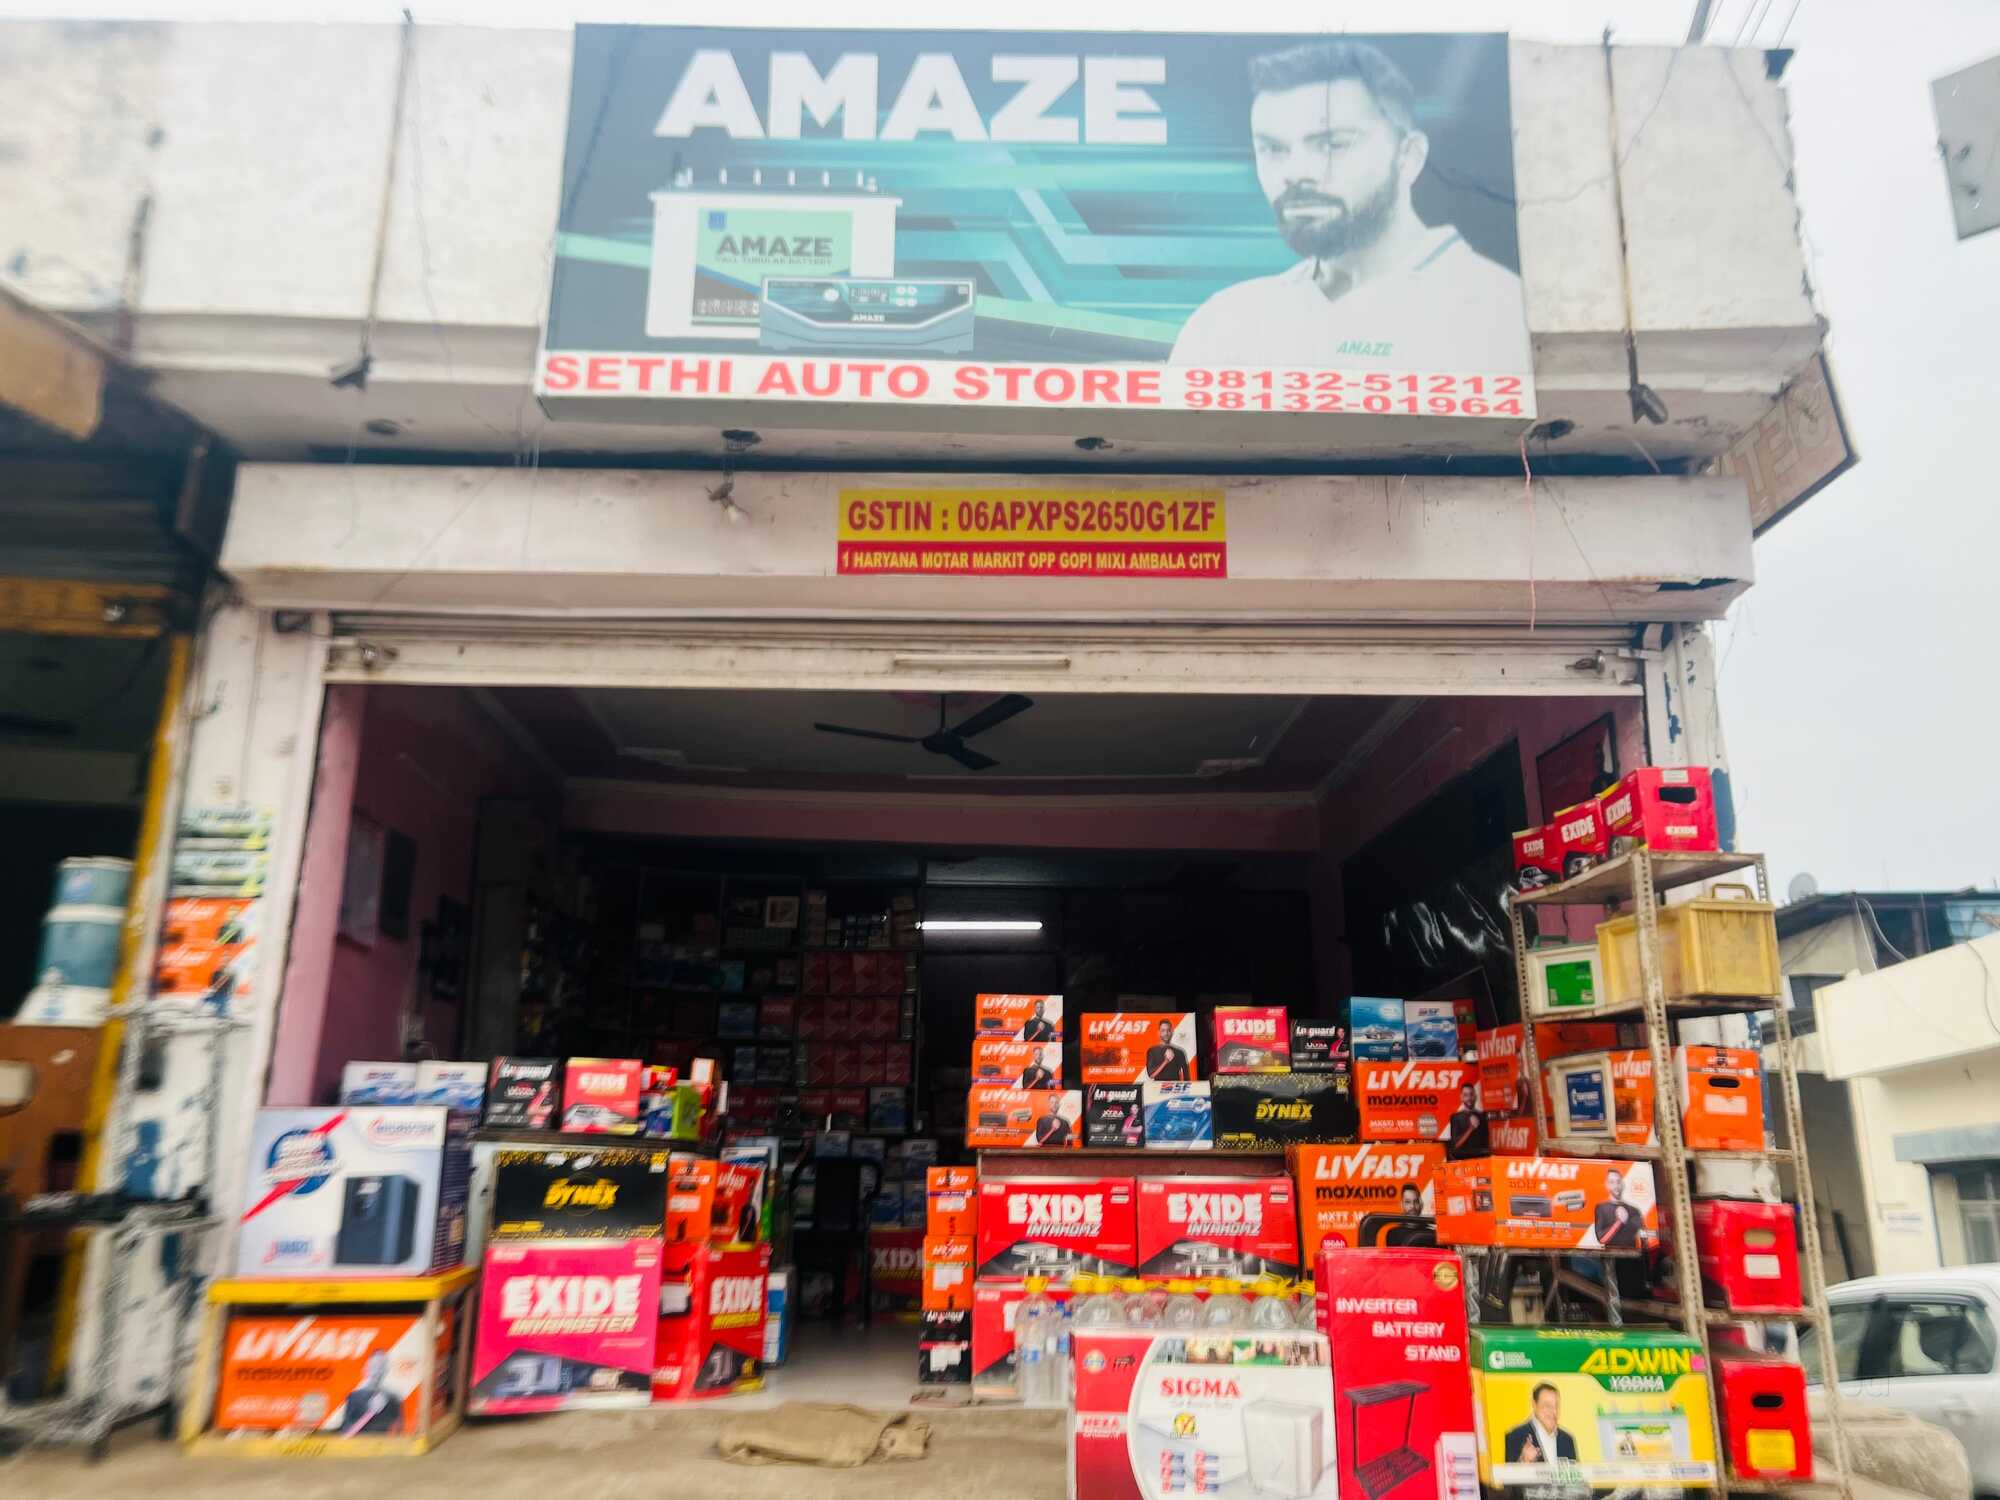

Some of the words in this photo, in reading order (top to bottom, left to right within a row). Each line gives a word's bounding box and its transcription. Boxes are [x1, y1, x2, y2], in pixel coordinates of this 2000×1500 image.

[654, 49, 1168, 145] AMAZE
[716, 235, 833, 258] AMAZE
[1336, 341, 1394, 357] AMAZE
[543, 355, 733, 394] SETHI
[755, 360, 930, 401] AUTO
[952, 366, 1162, 405] STORE
[1184, 368, 1523, 396] 98132-51212
[1183, 390, 1523, 417] 98132-01964
[847, 500, 932, 531] GSTIN
[957, 501, 1216, 533] 06APXPS2650G1ZF
[842, 551, 849, 567] 1
[853, 551, 918, 569] HARYANA
[922, 552, 968, 569] MOTAR
[973, 552, 1025, 569] MARKIT
[1029, 552, 1055, 569] OPP
[1059, 552, 1092, 569] GOPI
[1097, 552, 1126, 569] MIXI
[1129, 553, 1185, 570] AMBALA
[1189, 553, 1221, 570] CITY
[1561, 815, 1595, 843] EXIDE
[1089, 1013, 1151, 1034] LIVFAST
[1223, 1018, 1277, 1036] EXIDE
[1367, 1056, 1464, 1091] LIVFAST
[1256, 1103, 1313, 1119] DYNEX
[1315, 1143, 1425, 1180] LIVFAST
[1507, 1156, 1580, 1180] LIVFAST
[1007, 1193, 1103, 1224] EXIDE
[1167, 1192, 1263, 1223] EXIDE
[500, 1274, 644, 1318] EXIDE
[709, 1274, 765, 1316] EXIDE
[1336, 1297, 1418, 1314] INVERTER
[1372, 1321, 1446, 1338] BATTERY
[1405, 1344, 1461, 1361] STAND
[1579, 1347, 1693, 1375] ADWIN
[1160, 1376, 1241, 1398] SIGMA
